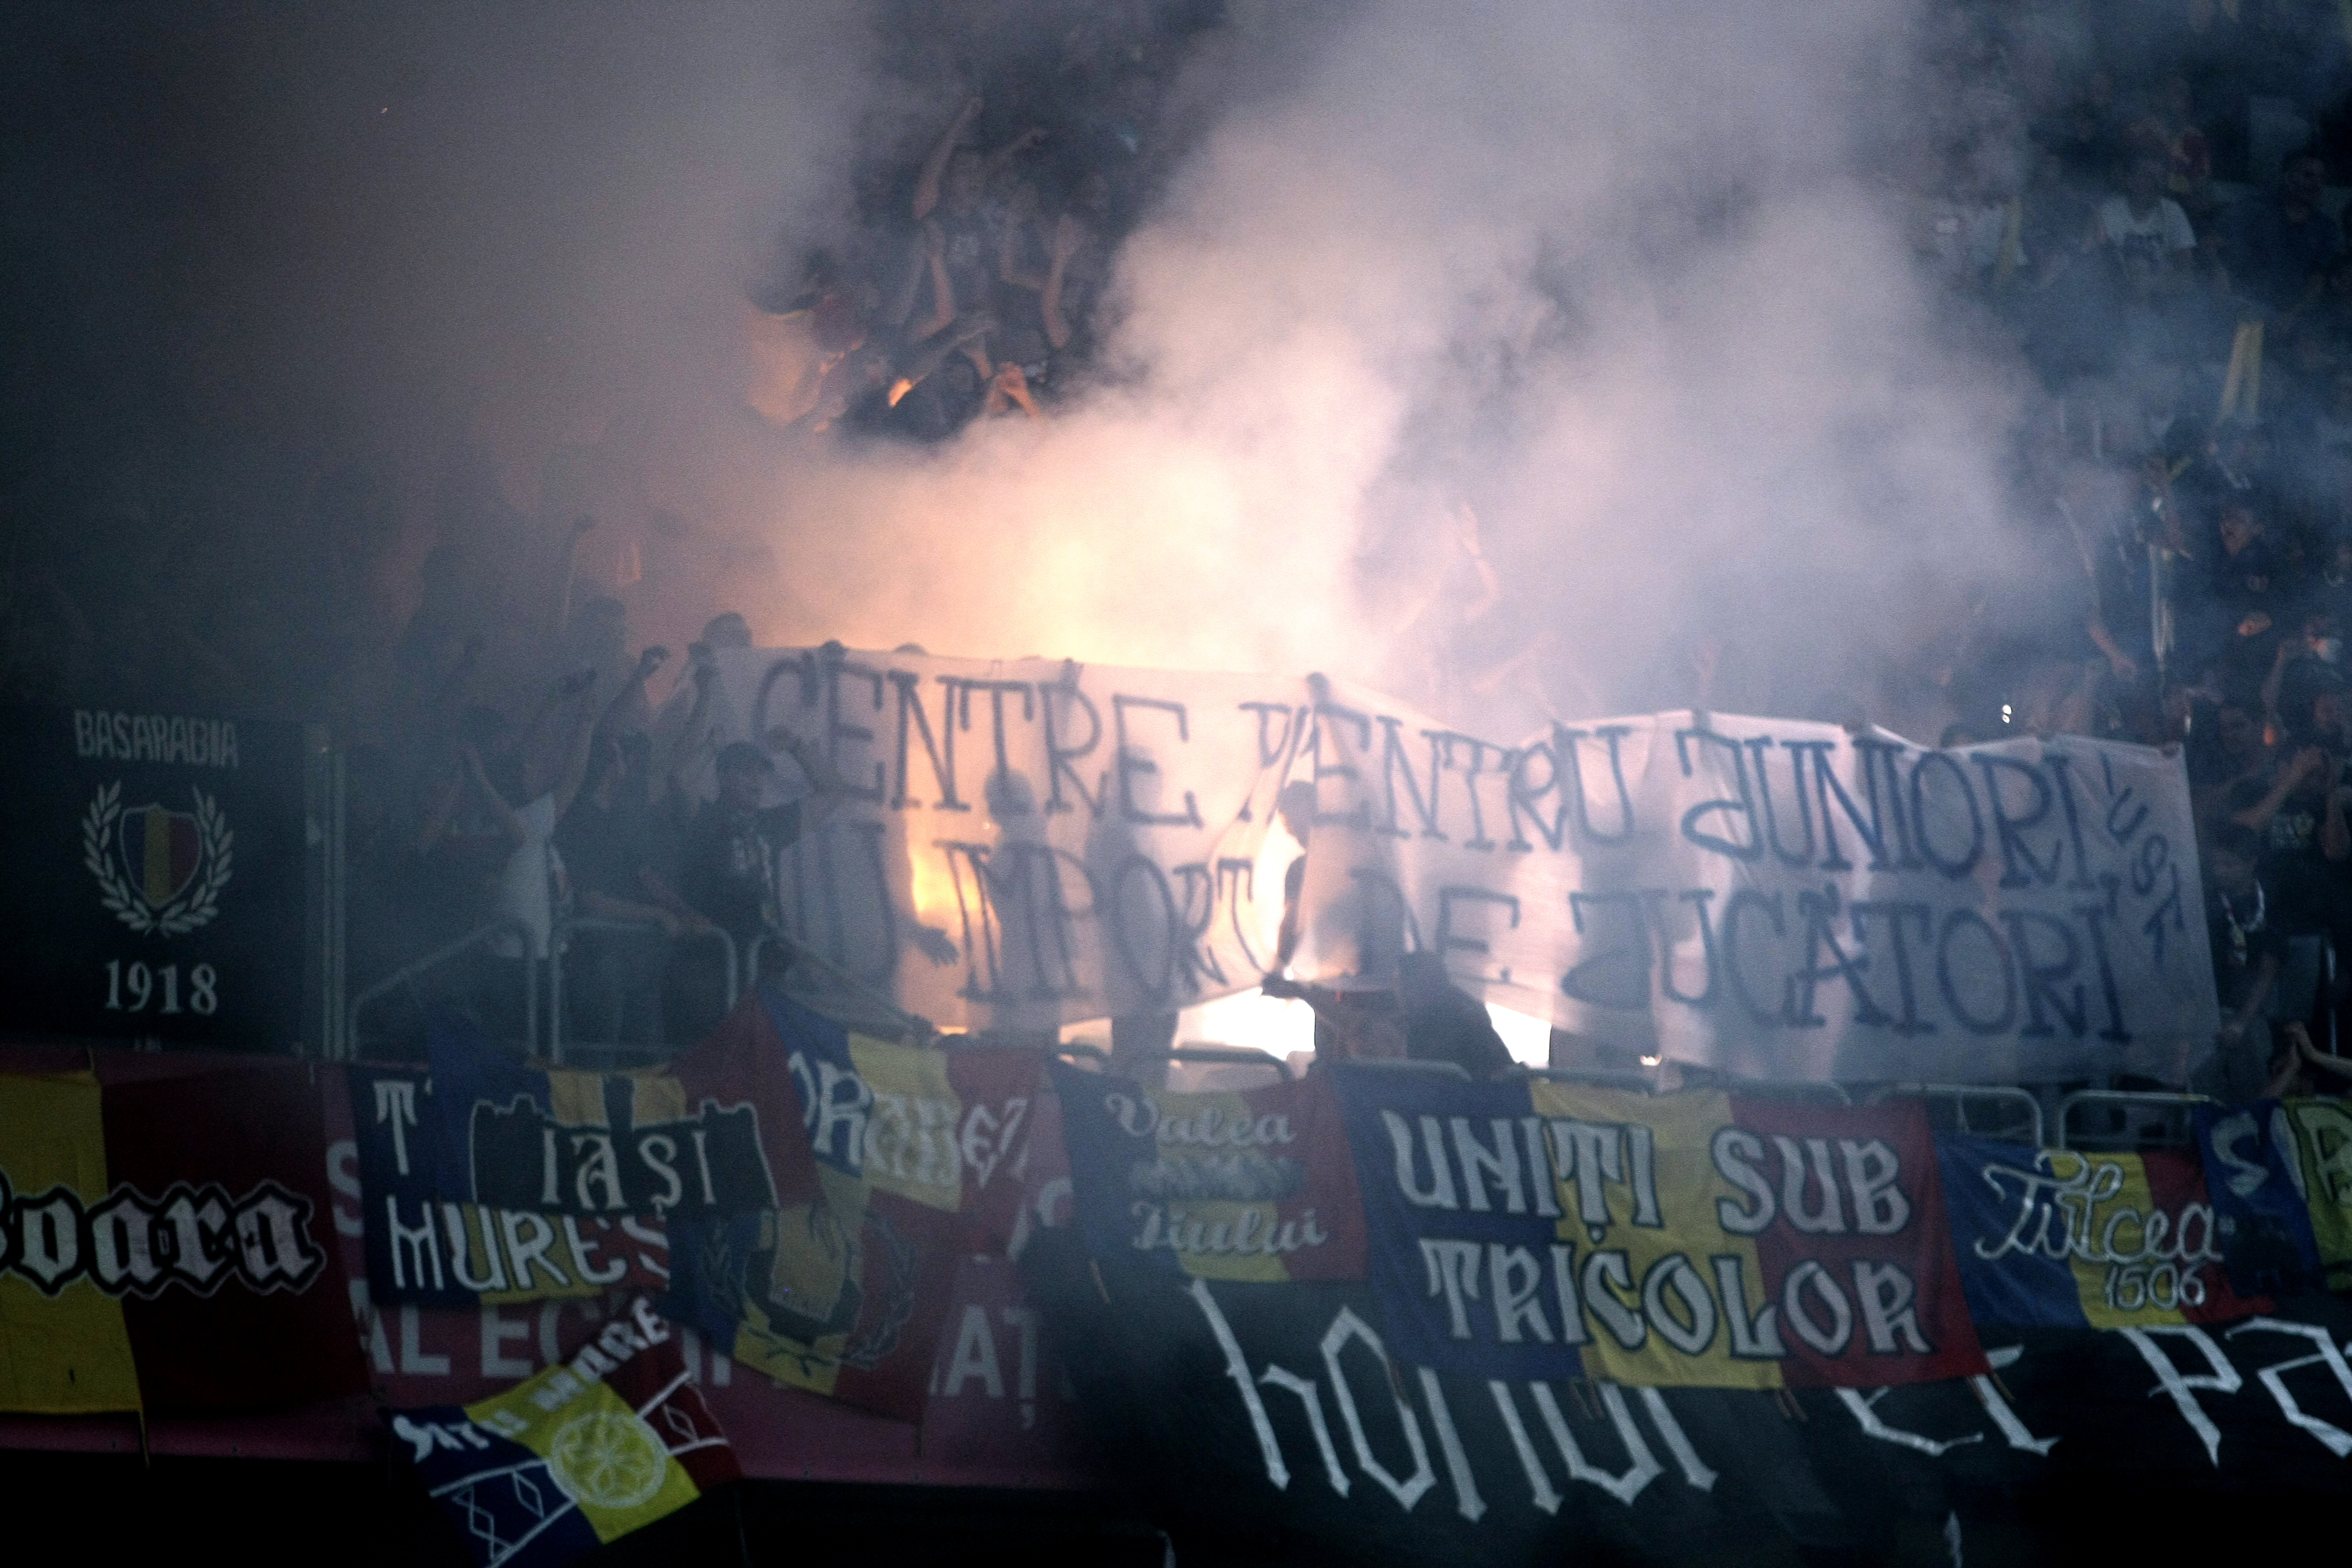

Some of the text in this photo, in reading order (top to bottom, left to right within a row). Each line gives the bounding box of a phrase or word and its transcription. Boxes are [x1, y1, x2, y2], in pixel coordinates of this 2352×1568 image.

[74, 708, 240, 769] BASARABIA
[104, 958, 219, 1017] 1918
[1103, 1091, 1297, 1146] Valea
[1710, 1126, 1910, 1236] SUB
[1973, 1149, 2224, 1263] Tulcea
[0, 1177, 325, 1299] oara
[1418, 1235, 1933, 1360] TRICOLOR
